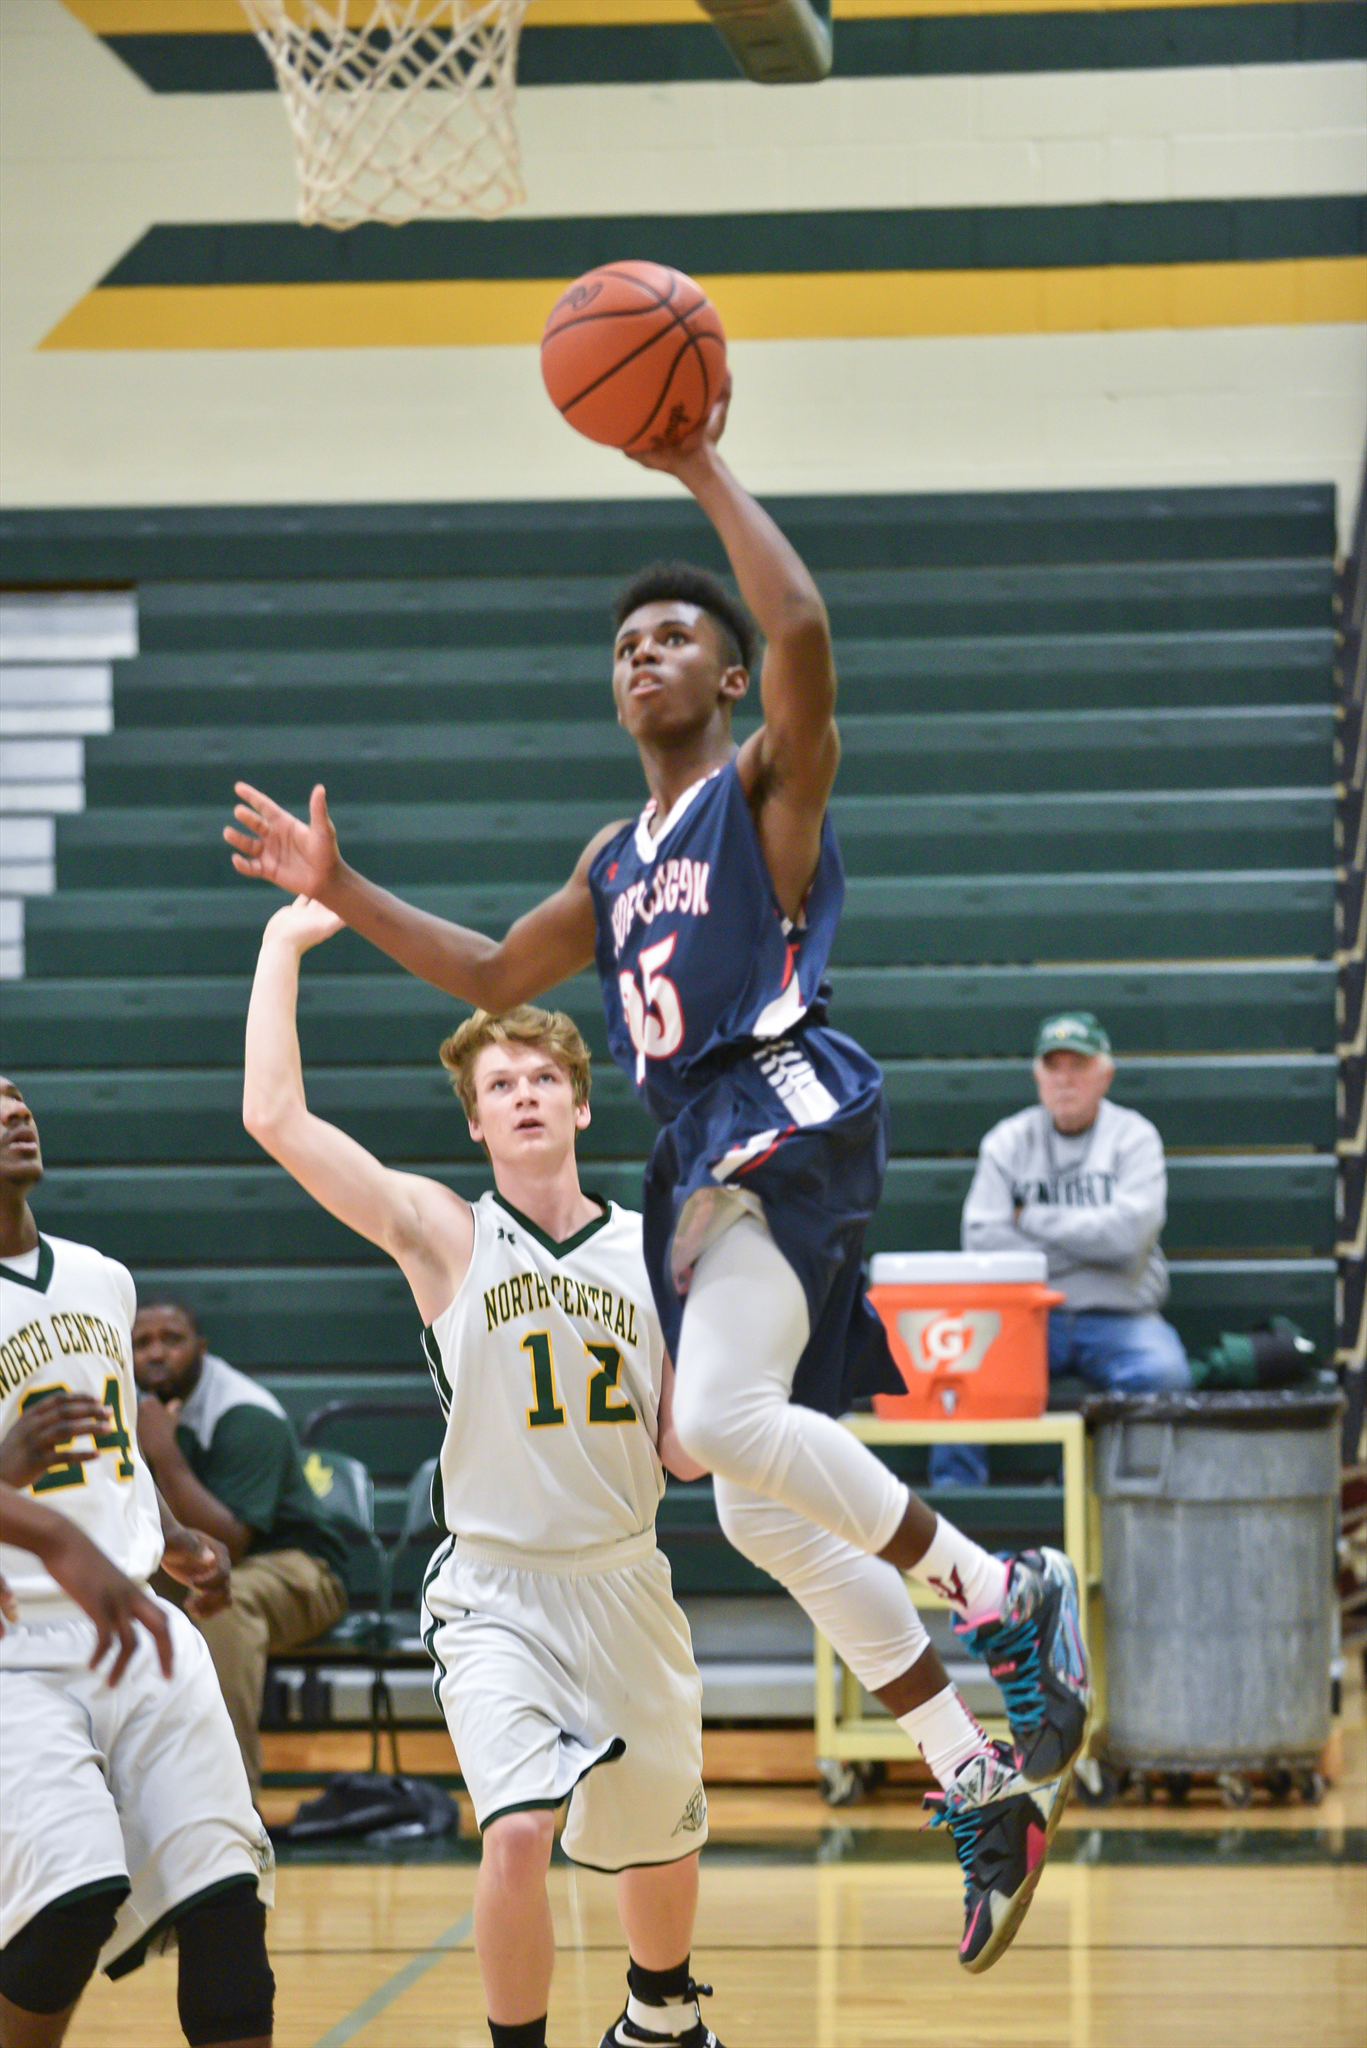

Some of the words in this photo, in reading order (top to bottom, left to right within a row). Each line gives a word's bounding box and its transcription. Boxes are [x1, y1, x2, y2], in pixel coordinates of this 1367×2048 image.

[50, 1311, 125, 1371] CENTRAL
[483, 1271, 551, 1333] NORTH
[550, 1273, 638, 1347] CENTRAL
[519, 1328, 639, 1431] 12
